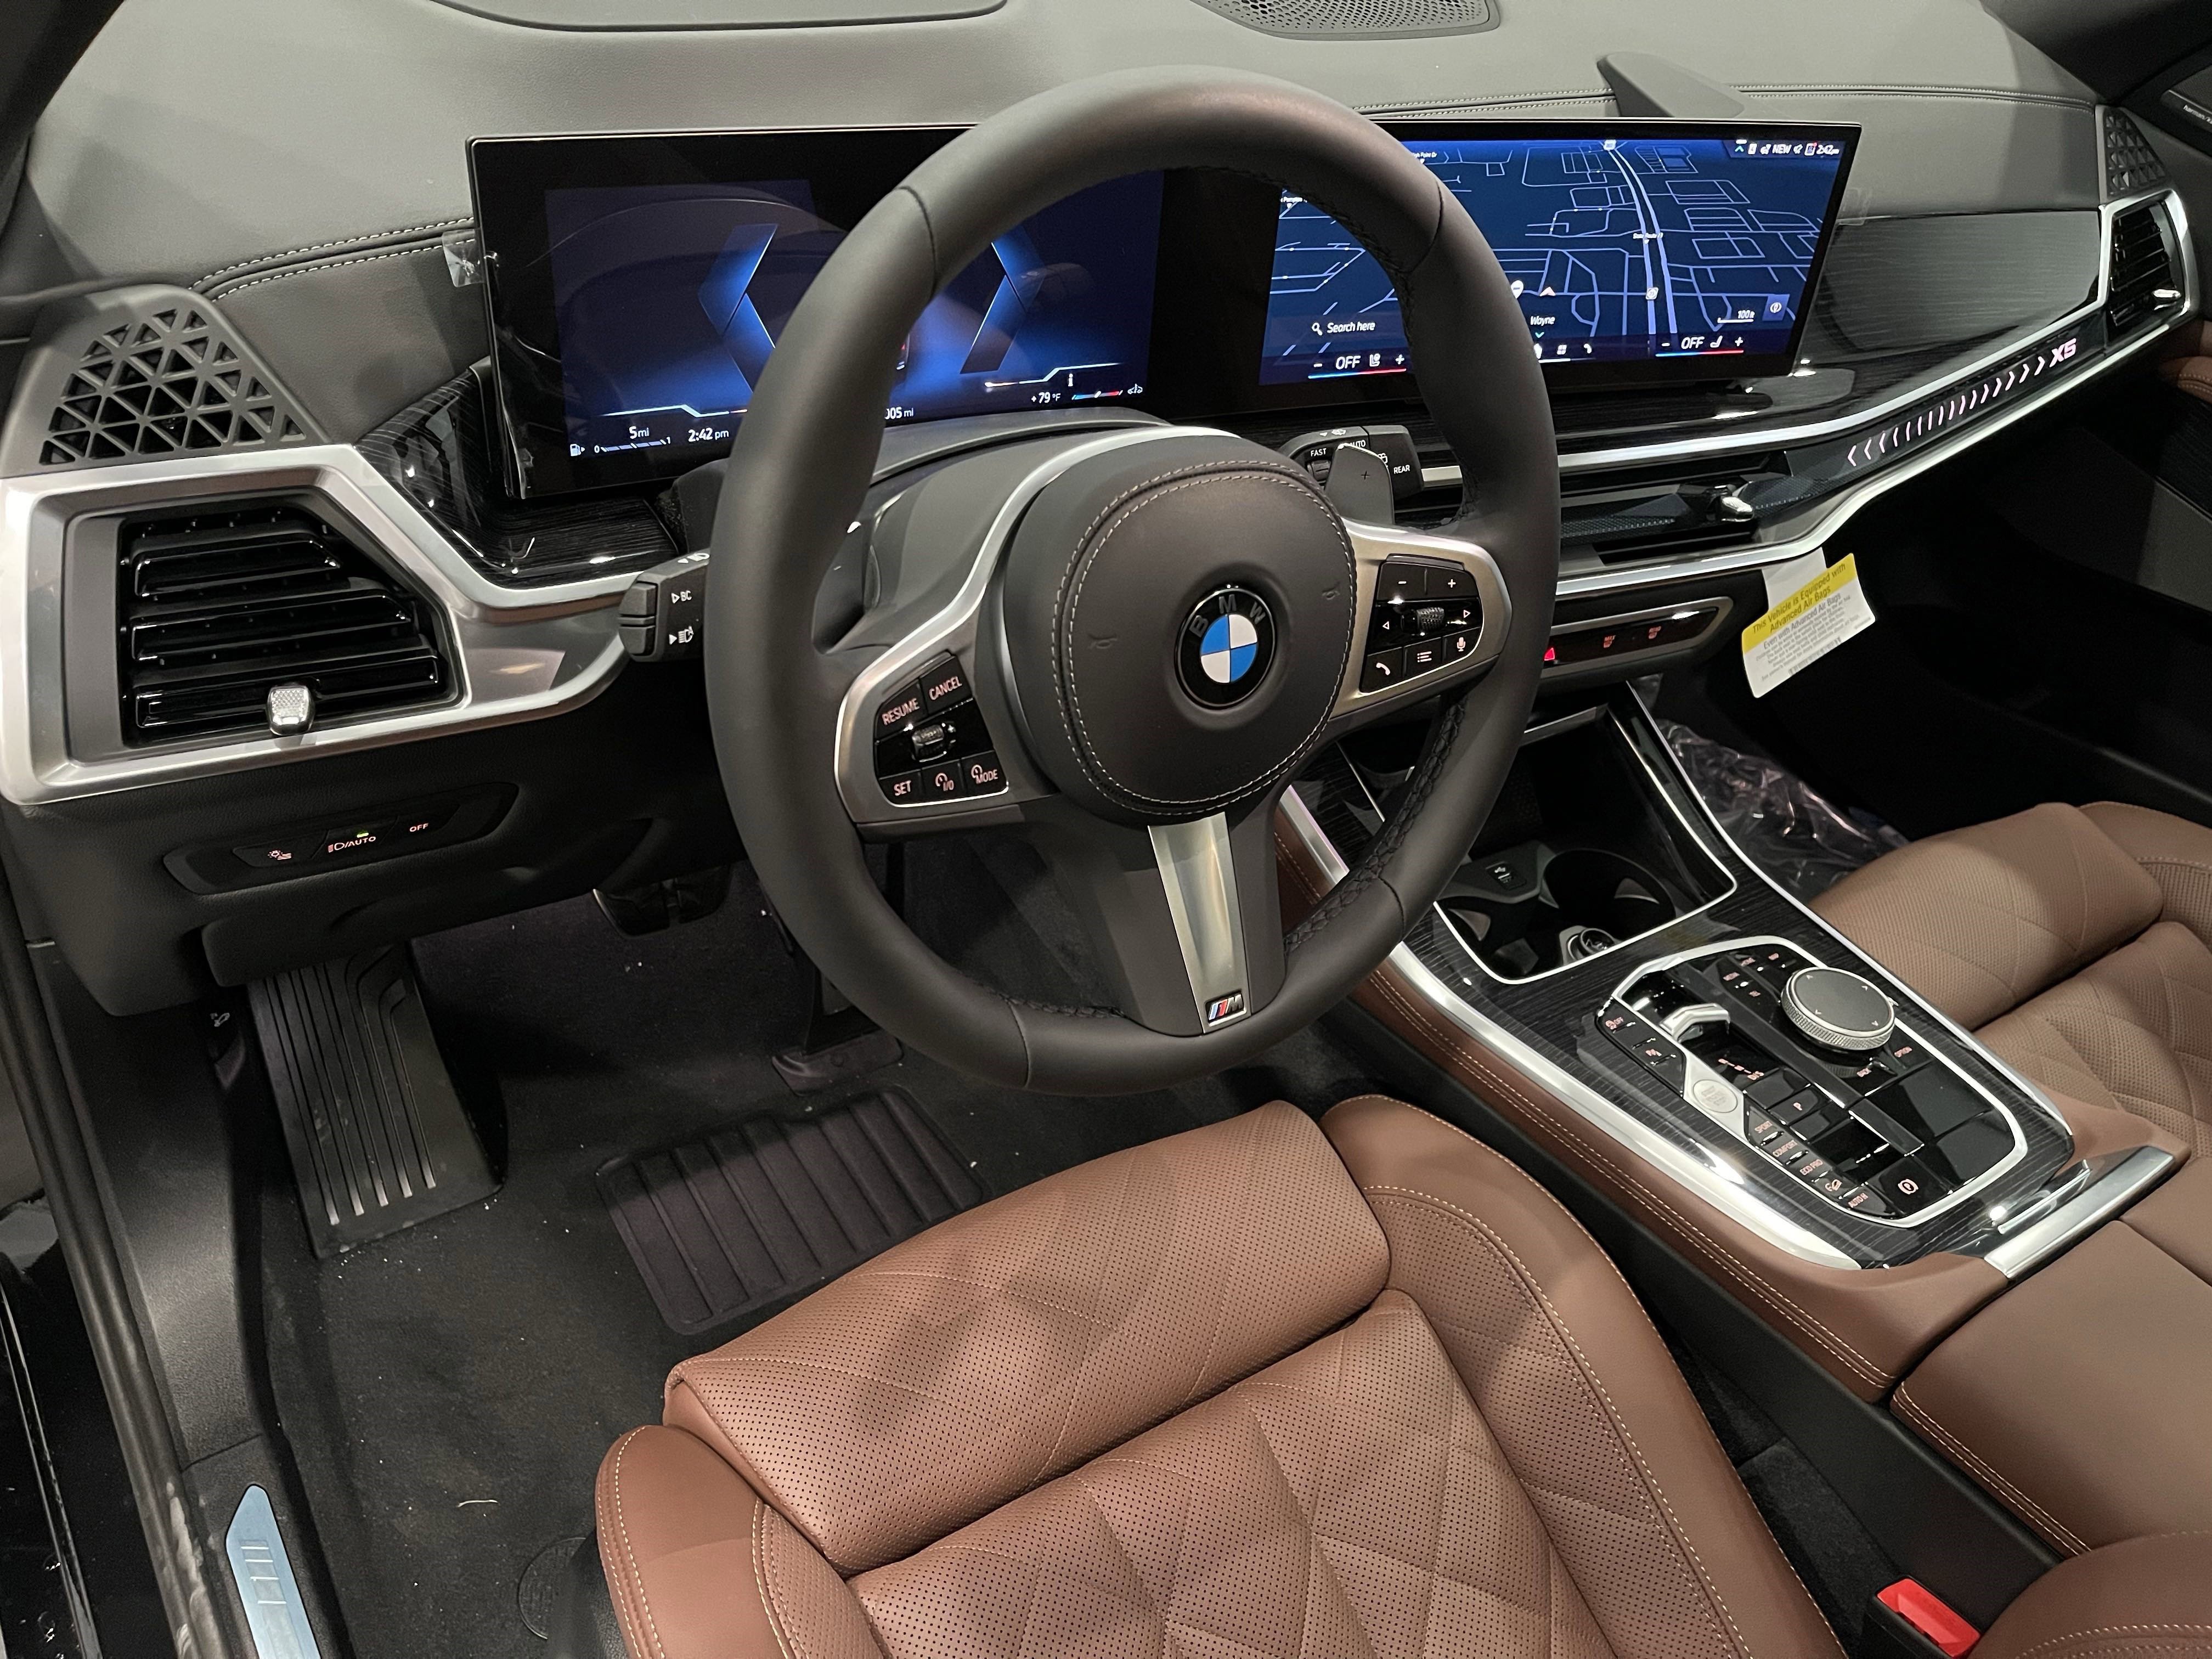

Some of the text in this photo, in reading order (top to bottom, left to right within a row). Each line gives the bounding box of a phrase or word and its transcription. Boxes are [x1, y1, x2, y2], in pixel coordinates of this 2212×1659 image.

[1771, 144, 1792, 154] NEW
[1327, 320, 1376, 334] Search here
[1530, 315, 1555, 326] Wayne
[1680, 336, 1705, 349] OFF
[2049, 338, 2076, 368] X5
[1335, 355, 1361, 370] OFF
[688, 426, 729, 442] 2:42 pm
[1310, 448, 1327, 457] FAST
[1393, 464, 1410, 475] REAR
[680, 590, 692, 602] BC
[1753, 563, 1846, 634] This Vehicle is Equipped with
[1188, 594, 1266, 638] BMW
[1770, 585, 1831, 632] Advanced Air Bags
[929, 676, 962, 700] CANCEL
[881, 697, 921, 726] RESUME
[975, 769, 1000, 785] MODE
[894, 780, 911, 796] SET
[409, 823, 428, 832] OFF
